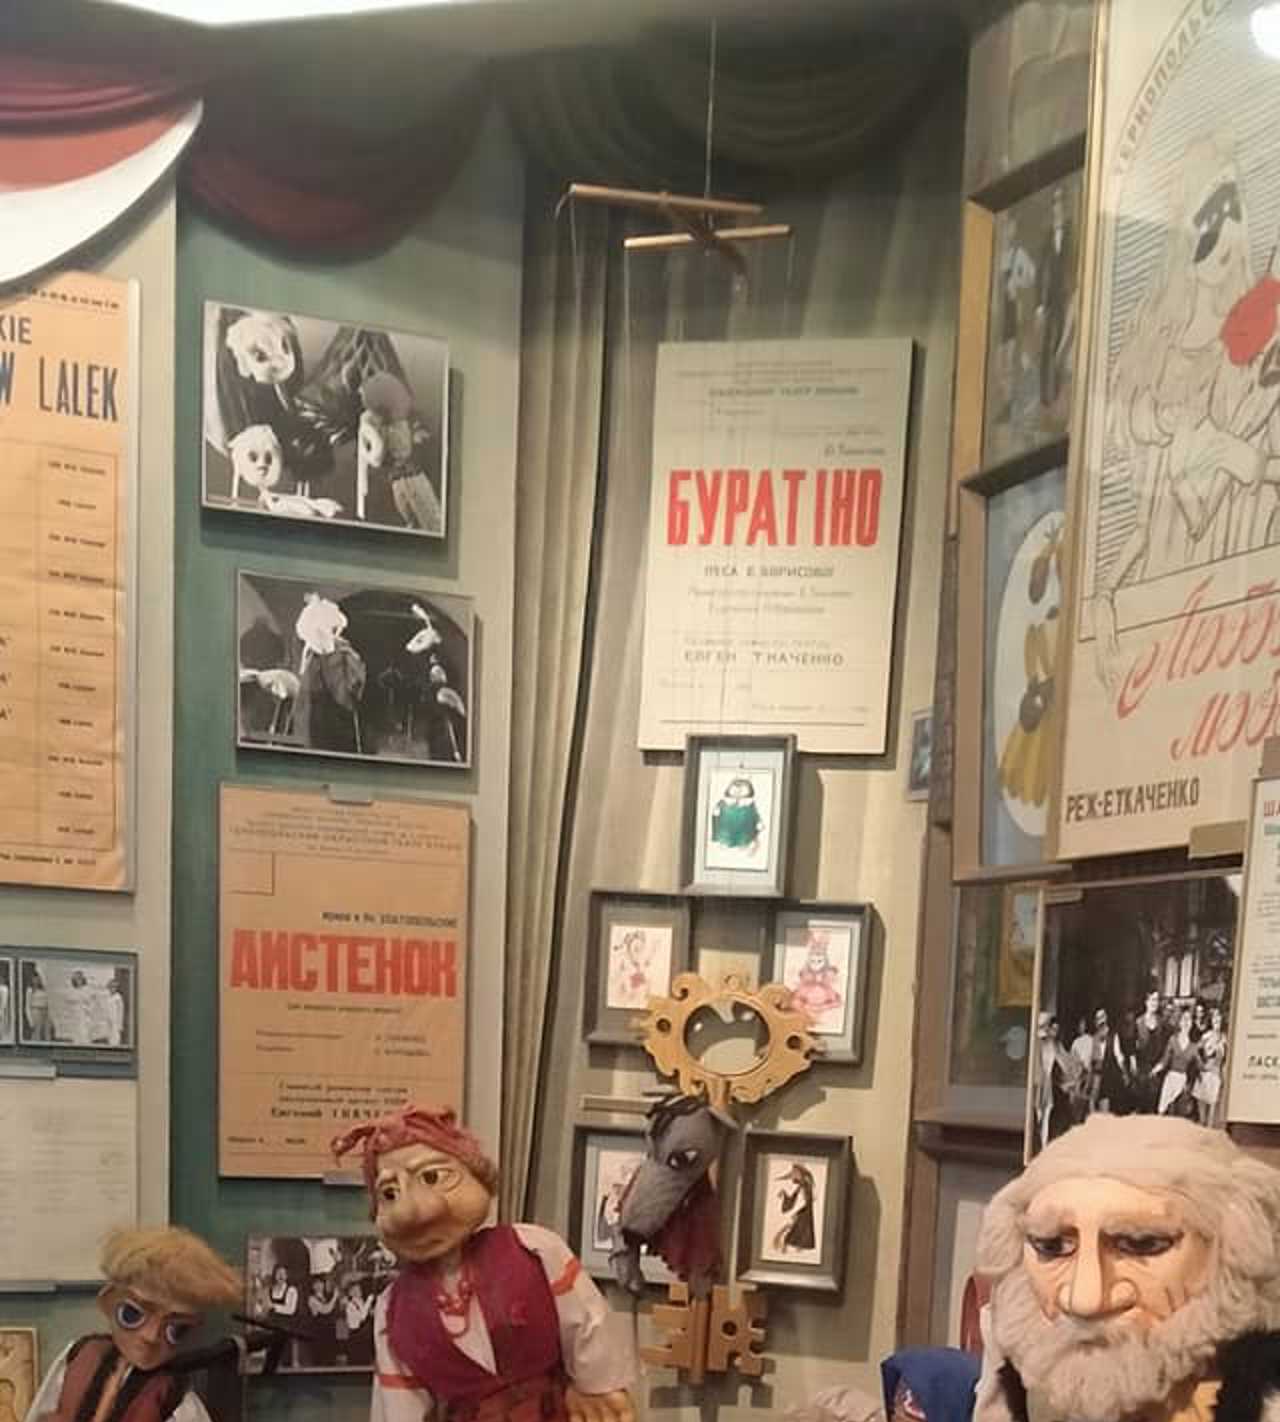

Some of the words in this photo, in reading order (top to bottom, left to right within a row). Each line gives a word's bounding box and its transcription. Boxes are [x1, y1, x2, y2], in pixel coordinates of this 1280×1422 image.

[39, 356, 118, 422] LALEK
[667, 468, 882, 546] БУРАТІНО
[231, 929, 457, 998] АИСТЕНОК
